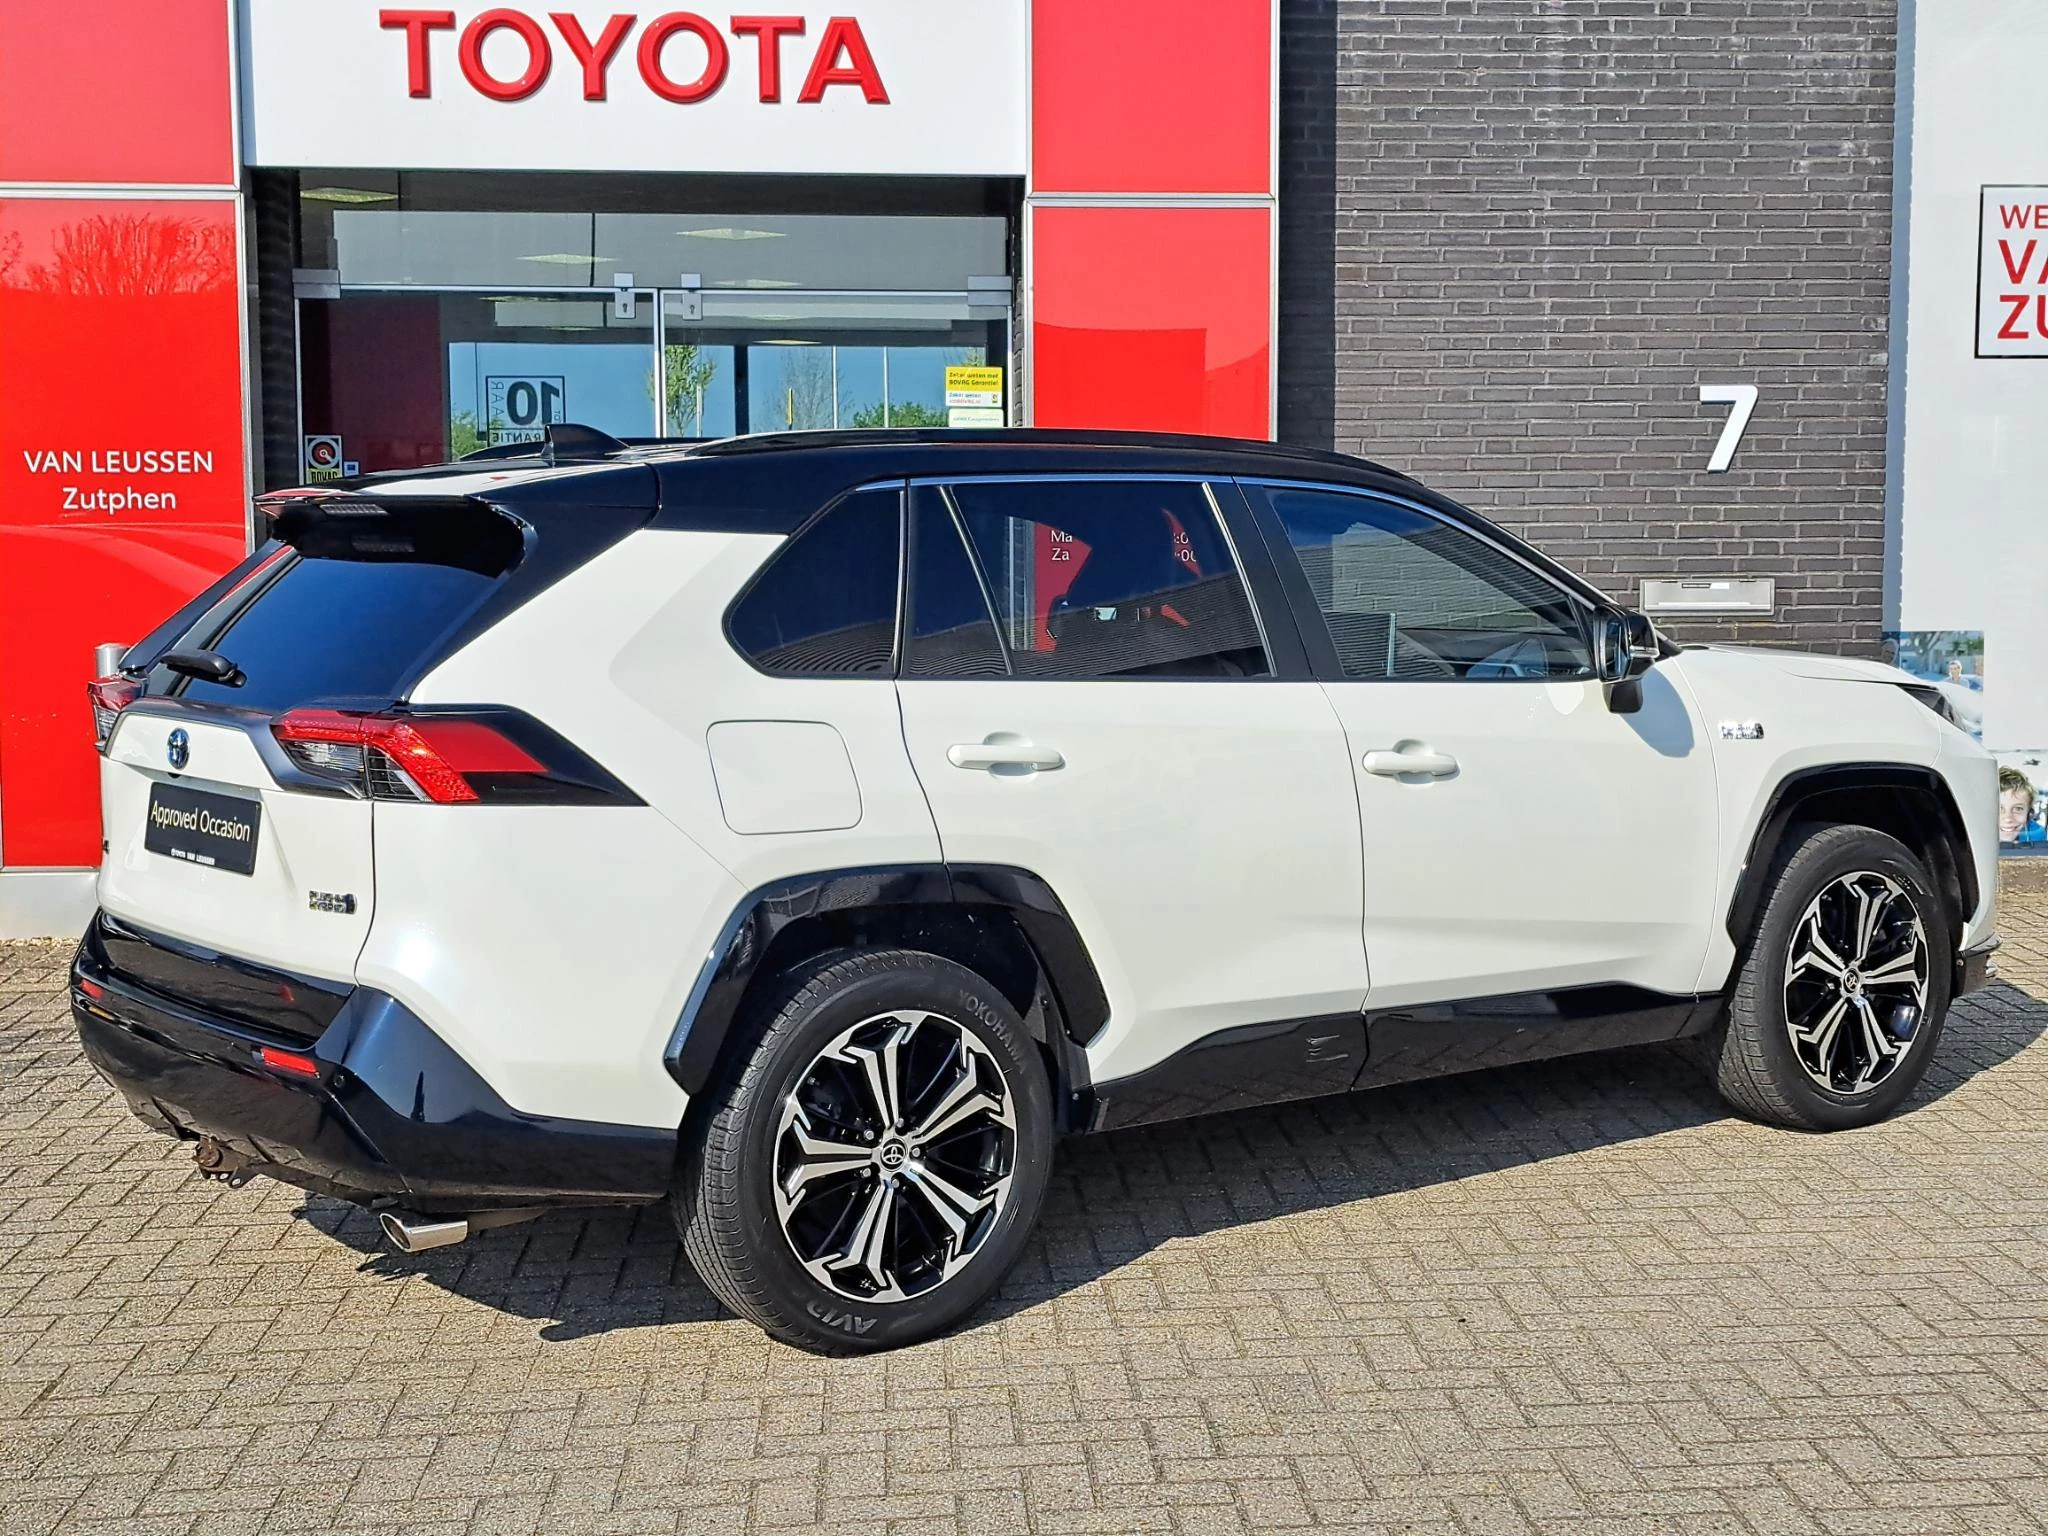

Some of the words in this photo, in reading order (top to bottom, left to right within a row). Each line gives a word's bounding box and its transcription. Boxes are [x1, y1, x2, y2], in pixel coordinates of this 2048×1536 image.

[379, 7, 891, 104] TOYOTA
[1998, 240, 2048, 284] V
[1700, 385, 1758, 471] 7
[23, 450, 82, 473] VAN
[91, 450, 213, 473] LEUSSEN
[62, 486, 177, 515] Zutphen
[1051, 530, 1073, 543] Ma
[1051, 548, 1070, 561] Za
[150, 799, 198, 830] Approved
[200, 810, 251, 842] Occasion
